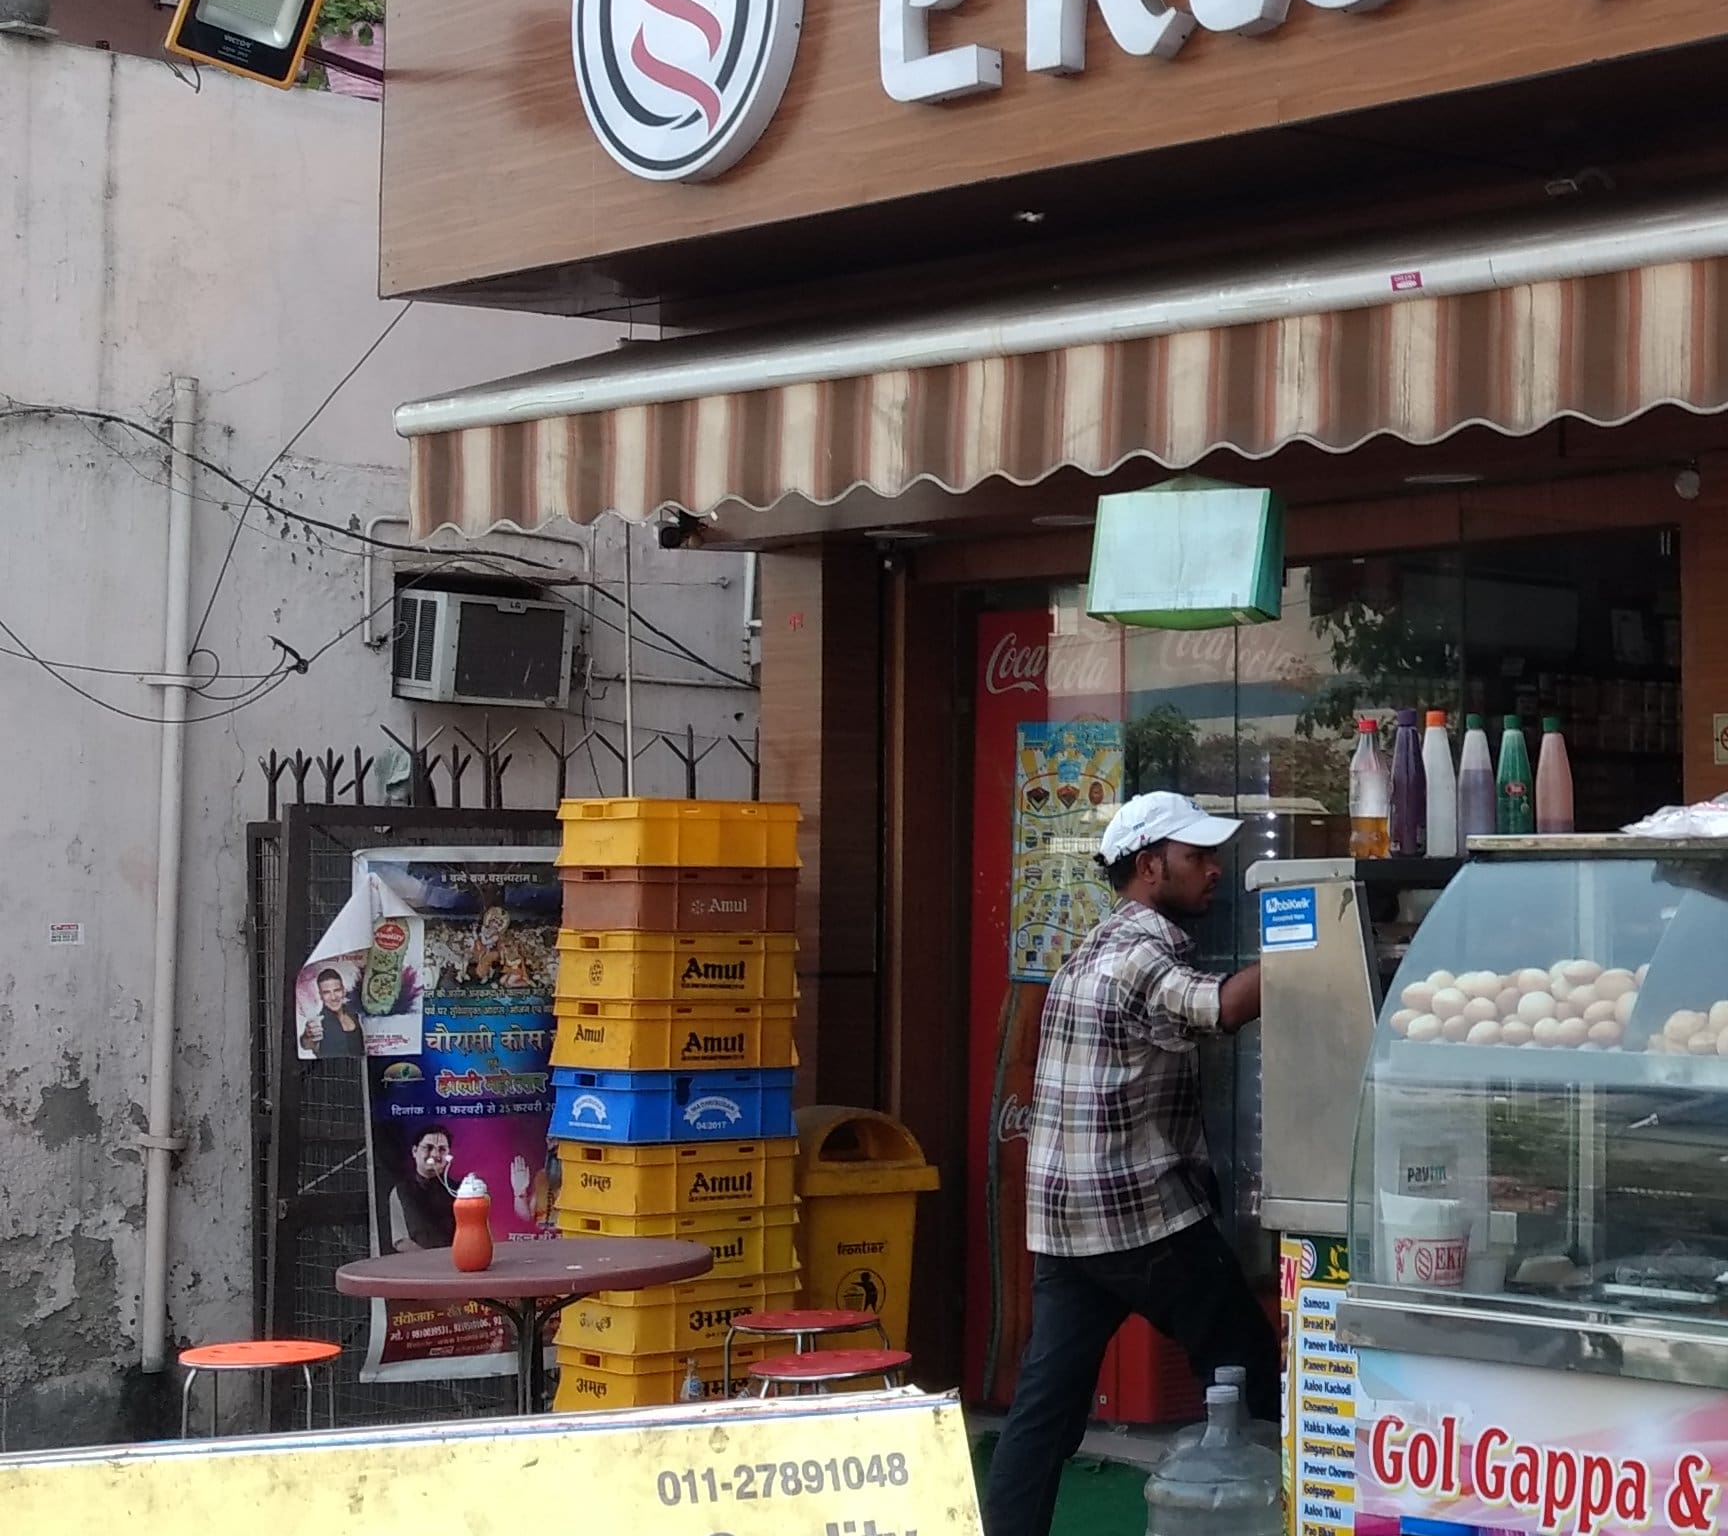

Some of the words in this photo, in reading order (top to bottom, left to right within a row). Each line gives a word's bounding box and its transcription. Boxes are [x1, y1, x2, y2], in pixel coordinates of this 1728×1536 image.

[708, 898, 747, 913] Amul
[681, 957, 745, 982] Amul
[574, 1024, 605, 1043] Amul
[681, 1032, 745, 1053] Amul
[689, 1171, 752, 1195] Amul
[837, 1241, 884, 1255] frontier
[1304, 1296, 1330, 1310] Samosa
[1304, 1337, 1327, 1352] Paneer
[1304, 1358, 1327, 1372] Paneer
[1304, 1461, 1327, 1476] Paneer
[1371, 1413, 1458, 1492] Gol
[1474, 1426, 1648, 1536] Gappa
[1667, 1455, 1714, 1531] &
[656, 1452, 910, 1509] 011-27891048
